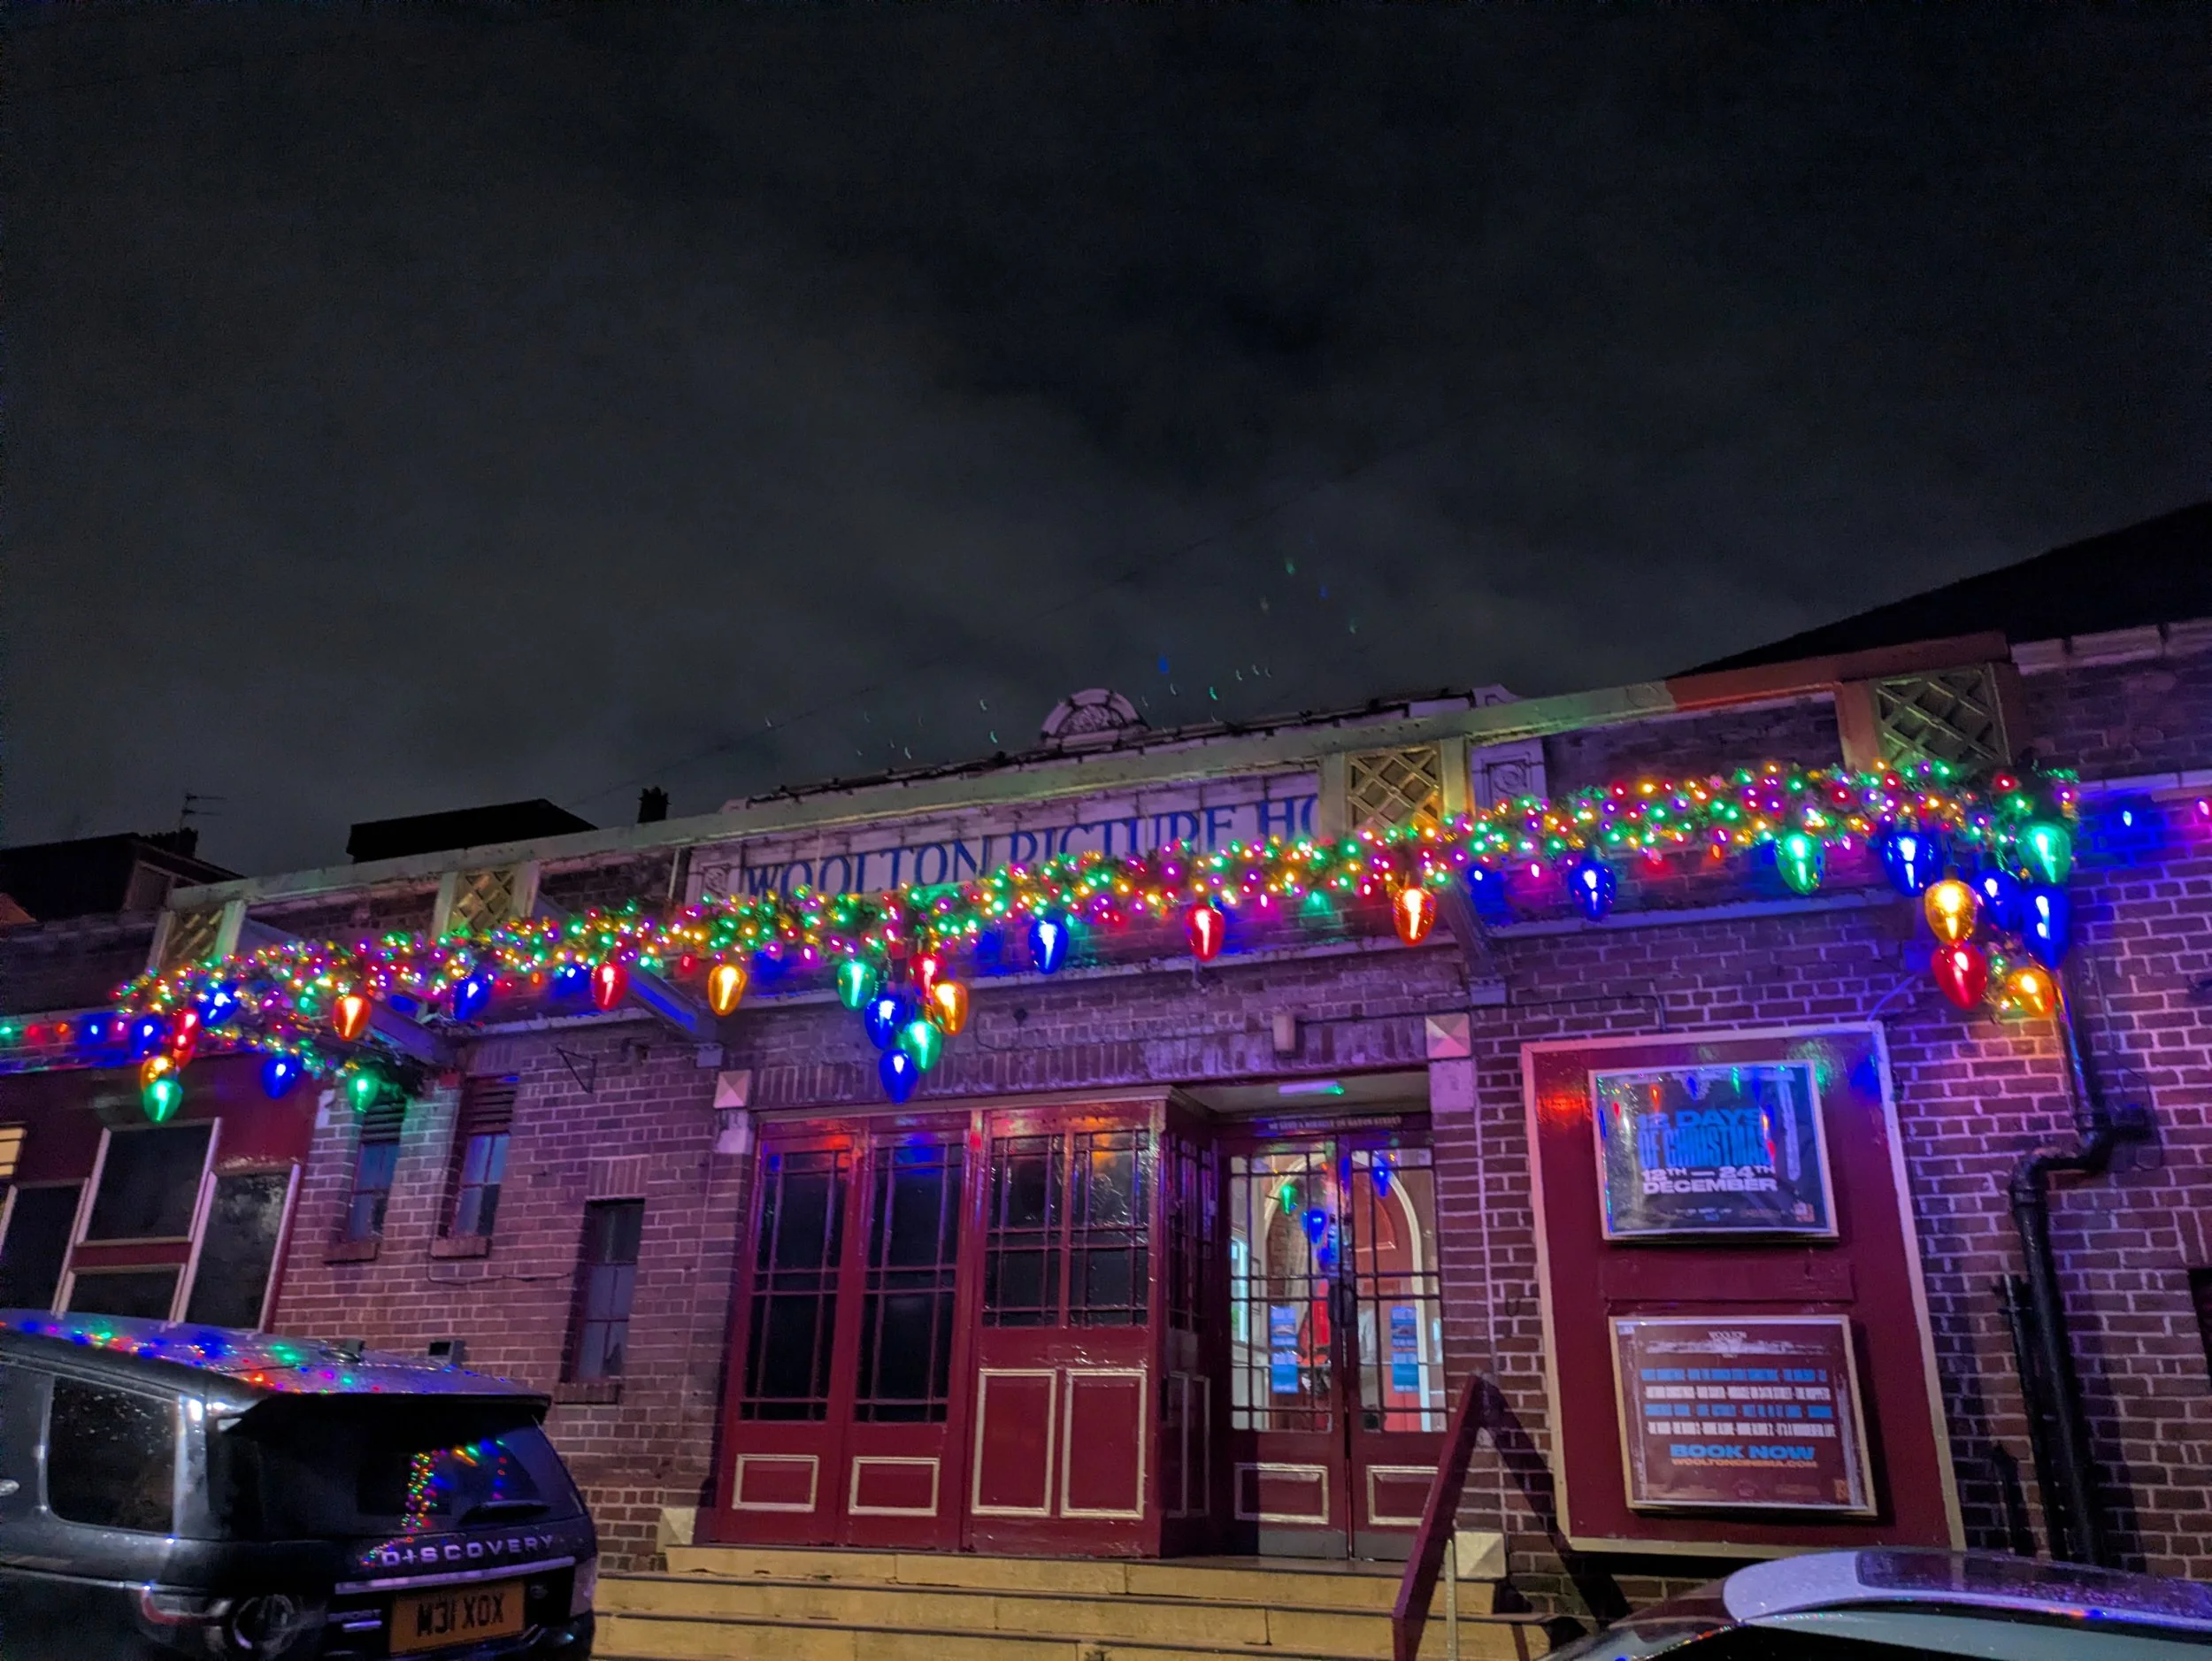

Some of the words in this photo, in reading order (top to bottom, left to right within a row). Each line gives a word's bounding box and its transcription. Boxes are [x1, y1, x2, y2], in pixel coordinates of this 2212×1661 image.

[745, 834, 992, 897] WOOLTON
[1009, 804, 1236, 864] PICTURE
[1637, 1113, 1671, 1128] 12
[1676, 1109, 1760, 1126] DAYS
[1638, 1129, 1660, 1168] OF
[1663, 1126, 1771, 1167] CHRISTMAS
[1641, 1168, 1687, 1181] 12TH
[1718, 1165, 1776, 1180] 24TH
[1643, 1180, 1778, 1194] DECEMBER
[1670, 1444, 1745, 1458] BOOK
[1748, 1445, 1816, 1459] NOW
[381, 1535, 554, 1566] DISCOVERY
[462, 1592, 505, 1629] XOX
